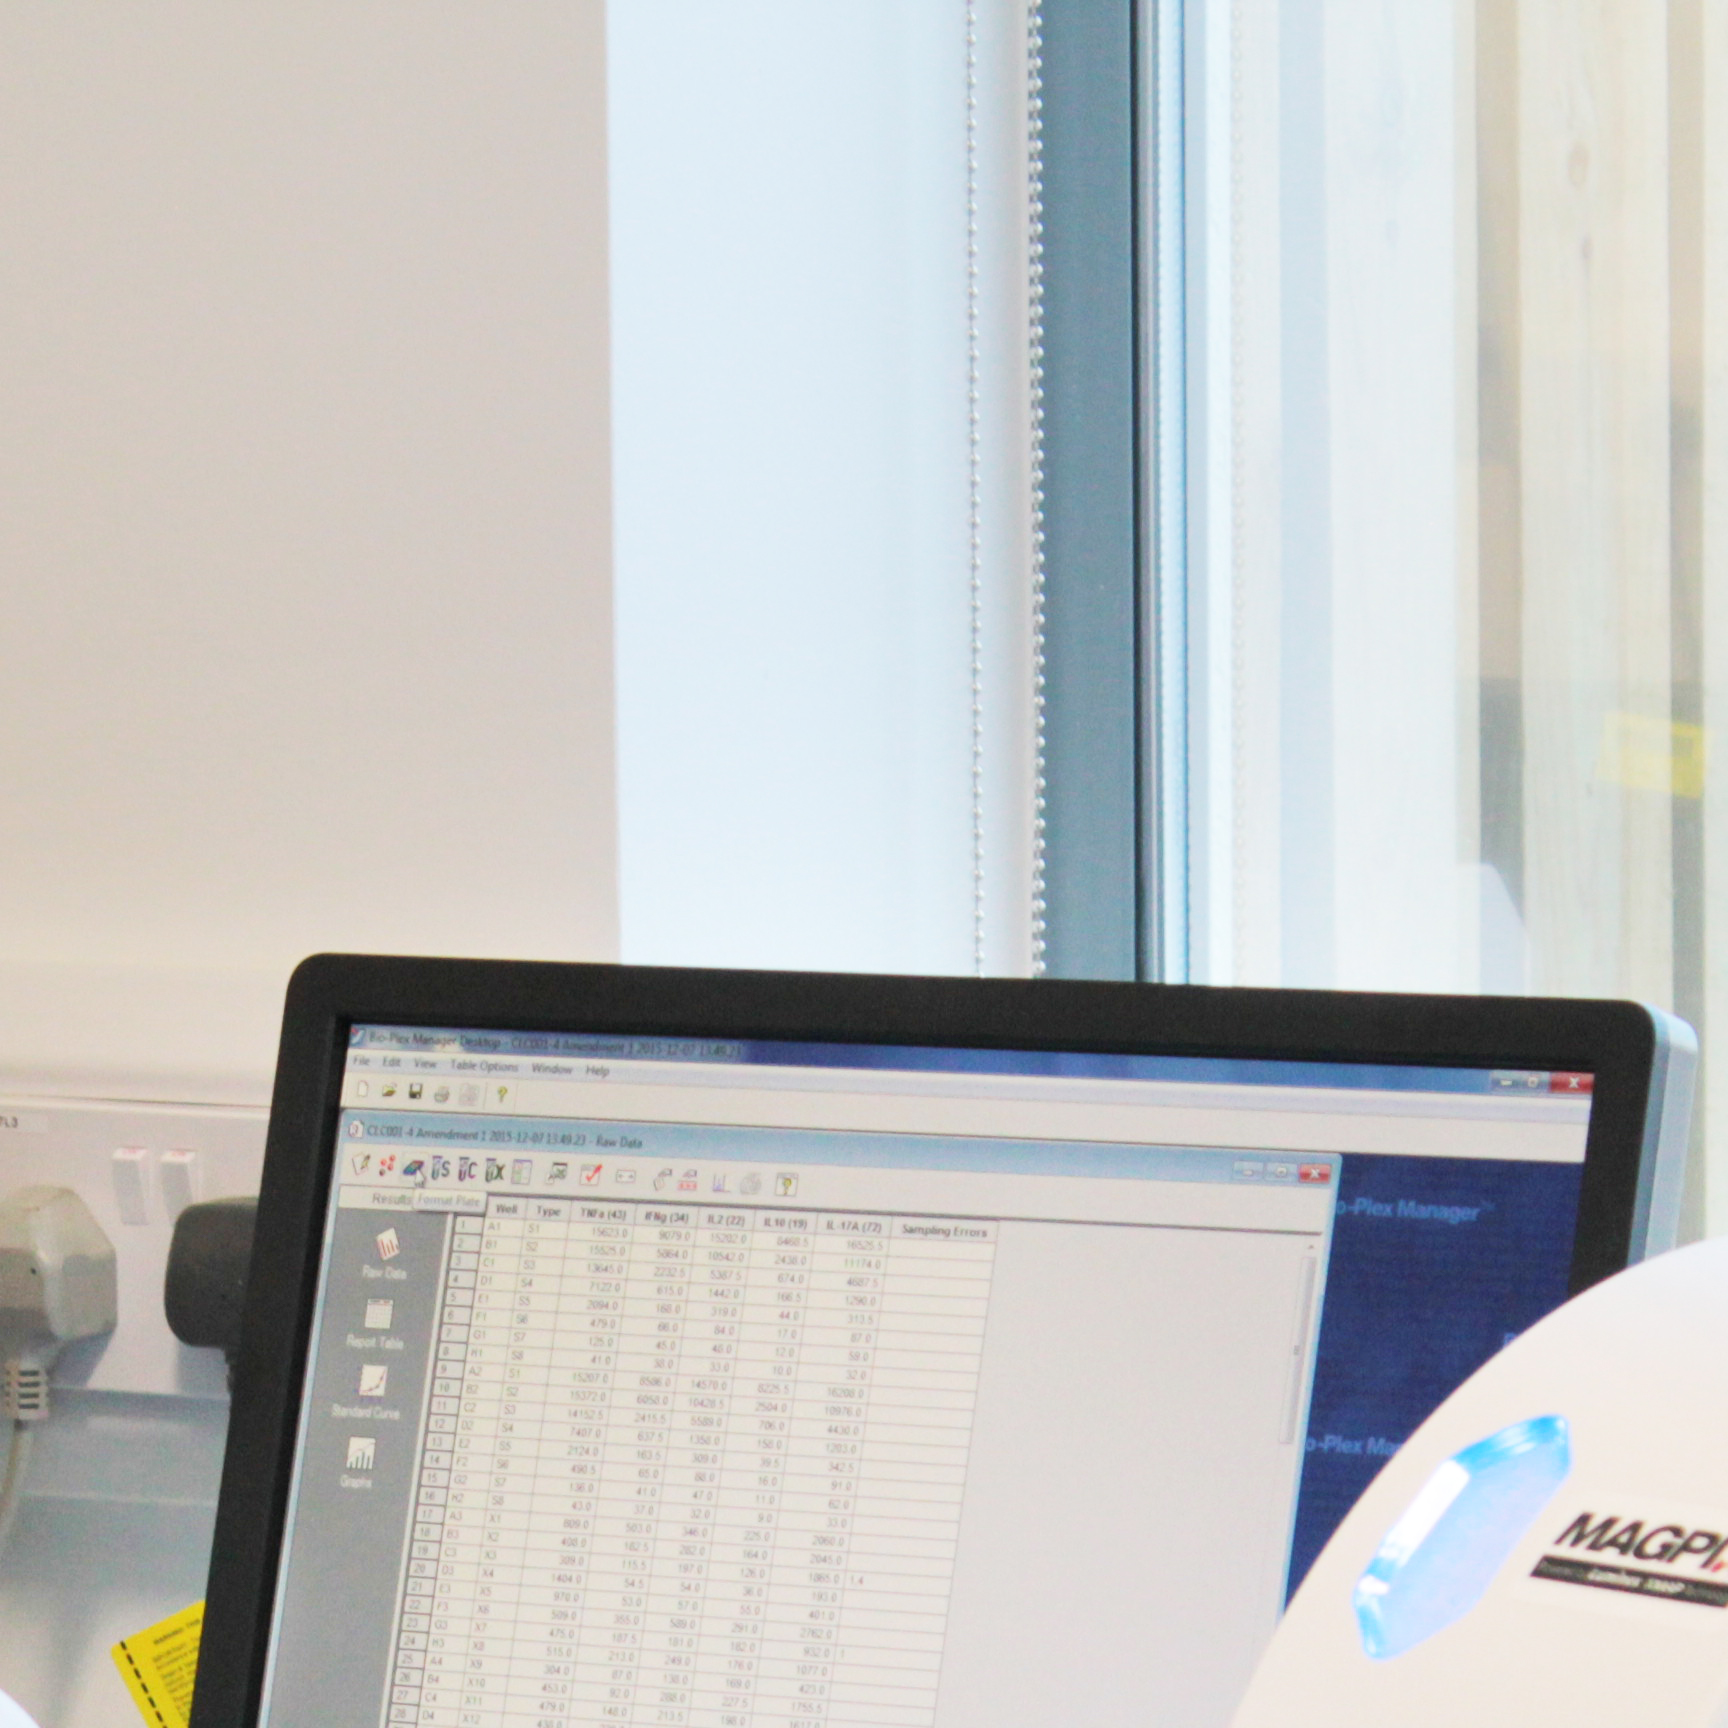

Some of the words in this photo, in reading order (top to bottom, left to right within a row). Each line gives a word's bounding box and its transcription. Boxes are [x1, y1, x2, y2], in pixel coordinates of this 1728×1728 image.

[353, 1055, 370, 1066] File
[383, 1057, 401, 1067] Edit
[414, 1058, 437, 1068] View
[451, 1059, 476, 1071] Table
[480, 1060, 519, 1073] Options
[531, 1063, 572, 1075] Window
[586, 1065, 610, 1078] Help
[417, 1128, 478, 1141] Amendment
[596, 1136, 616, 1148] Raw
[620, 1137, 643, 1149] Data
[372, 1192, 412, 1206] Results
[494, 1202, 518, 1215] Well
[535, 1204, 562, 1219] Type
[901, 1222, 952, 1238] Sampling
[952, 1225, 988, 1238] Errors
[385, 1265, 407, 1280] Data
